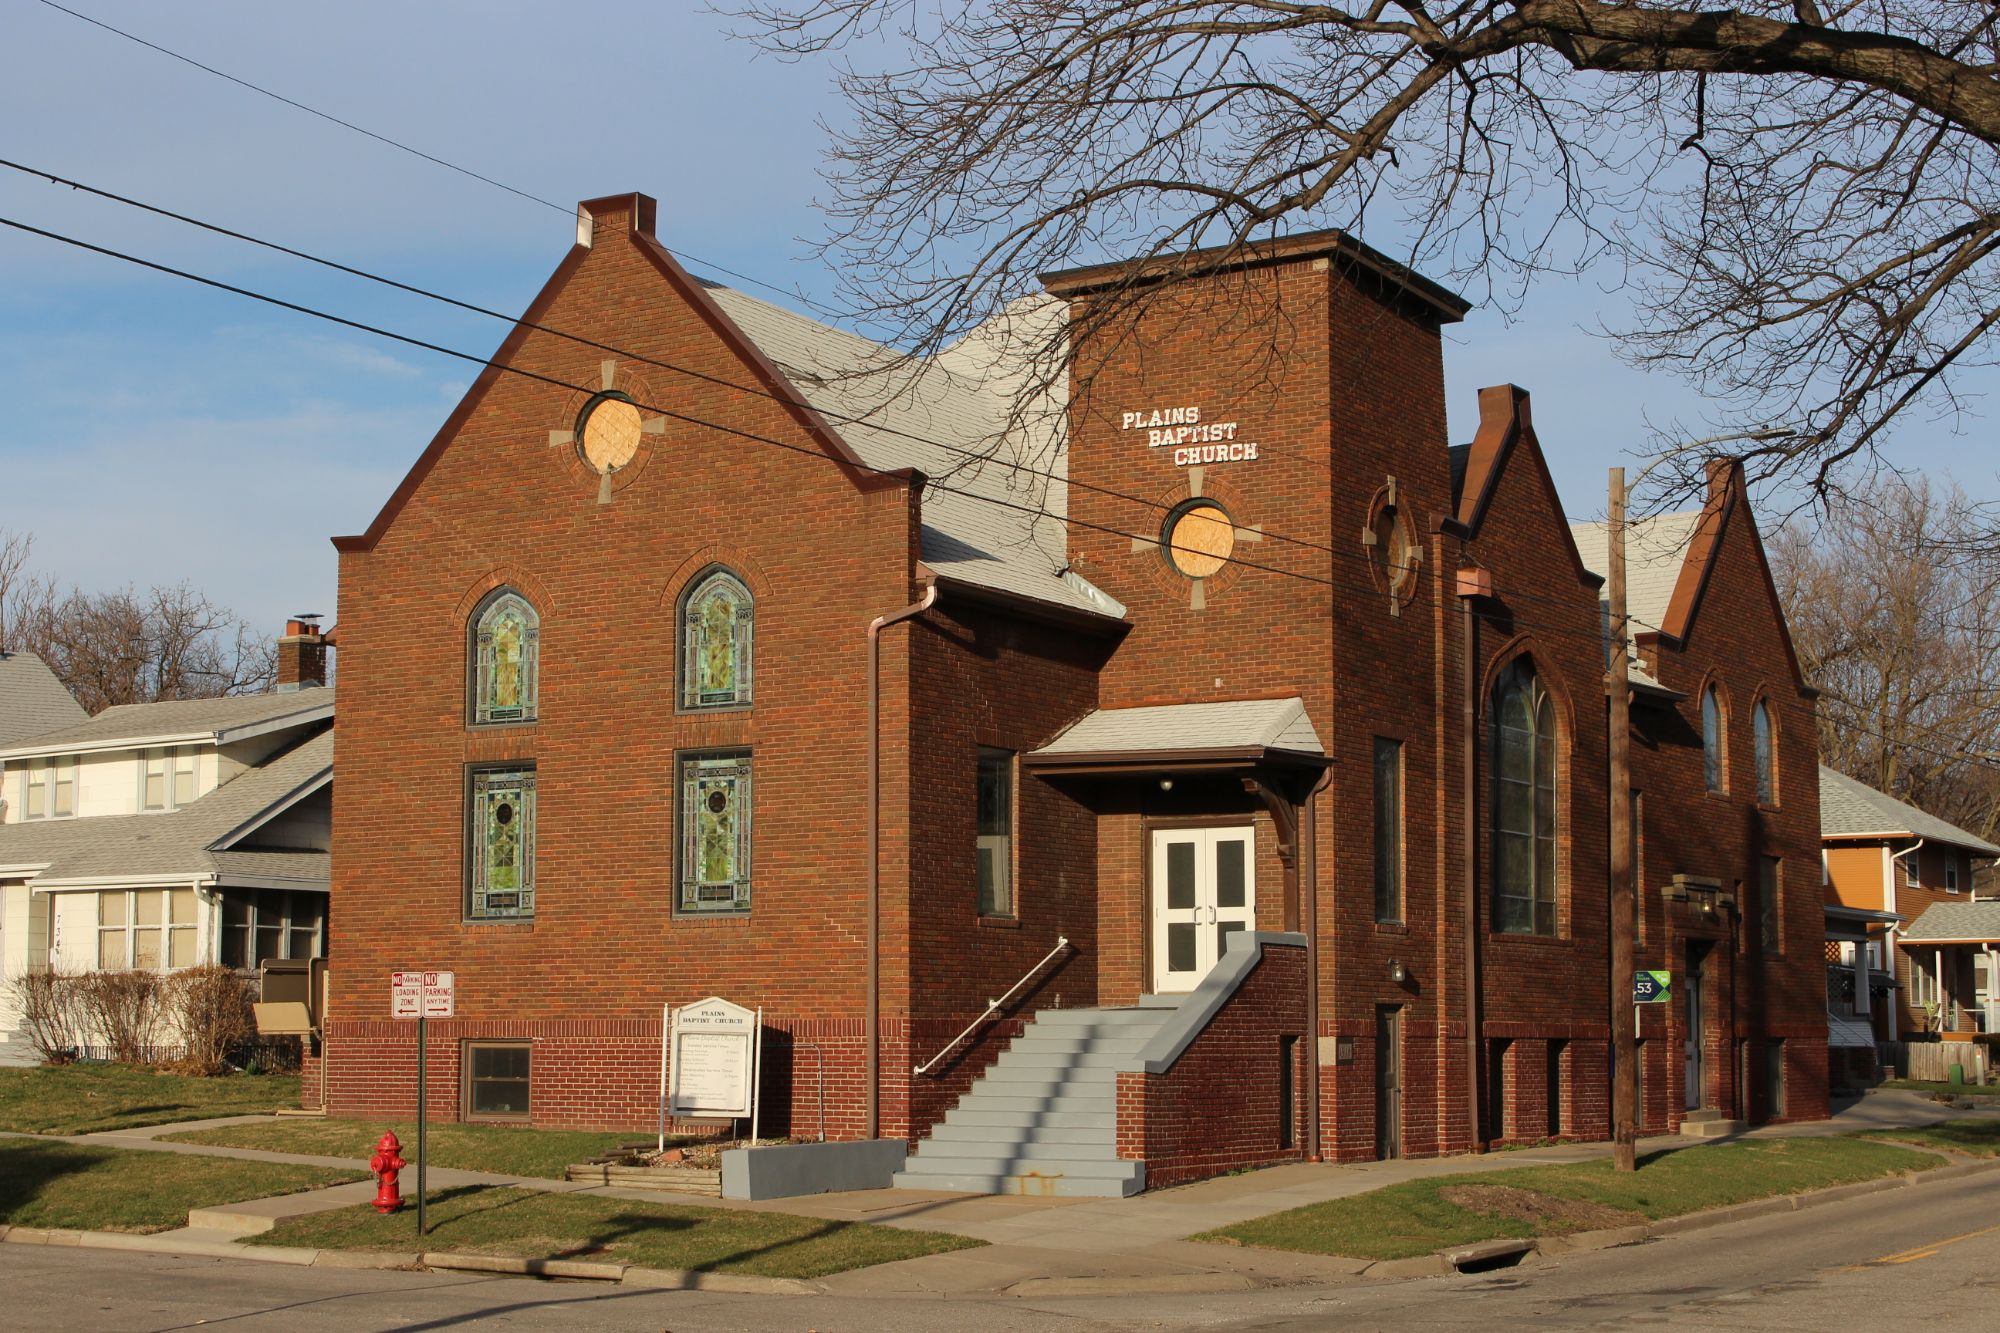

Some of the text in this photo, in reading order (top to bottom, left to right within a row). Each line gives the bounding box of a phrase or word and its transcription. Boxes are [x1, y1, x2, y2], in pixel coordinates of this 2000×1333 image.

[1122, 407, 1199, 430] PLAINS
[1148, 422, 1237, 448] BAPTIST
[1174, 443, 1258, 466] CHURCH
[393, 976, 422, 985] NO PARKING
[425, 973, 437, 986] NO
[395, 987, 420, 997] LOADING
[425, 987, 452, 997] PARKING
[1637, 982, 1652, 993] 53
[400, 998, 415, 1006] ZONE
